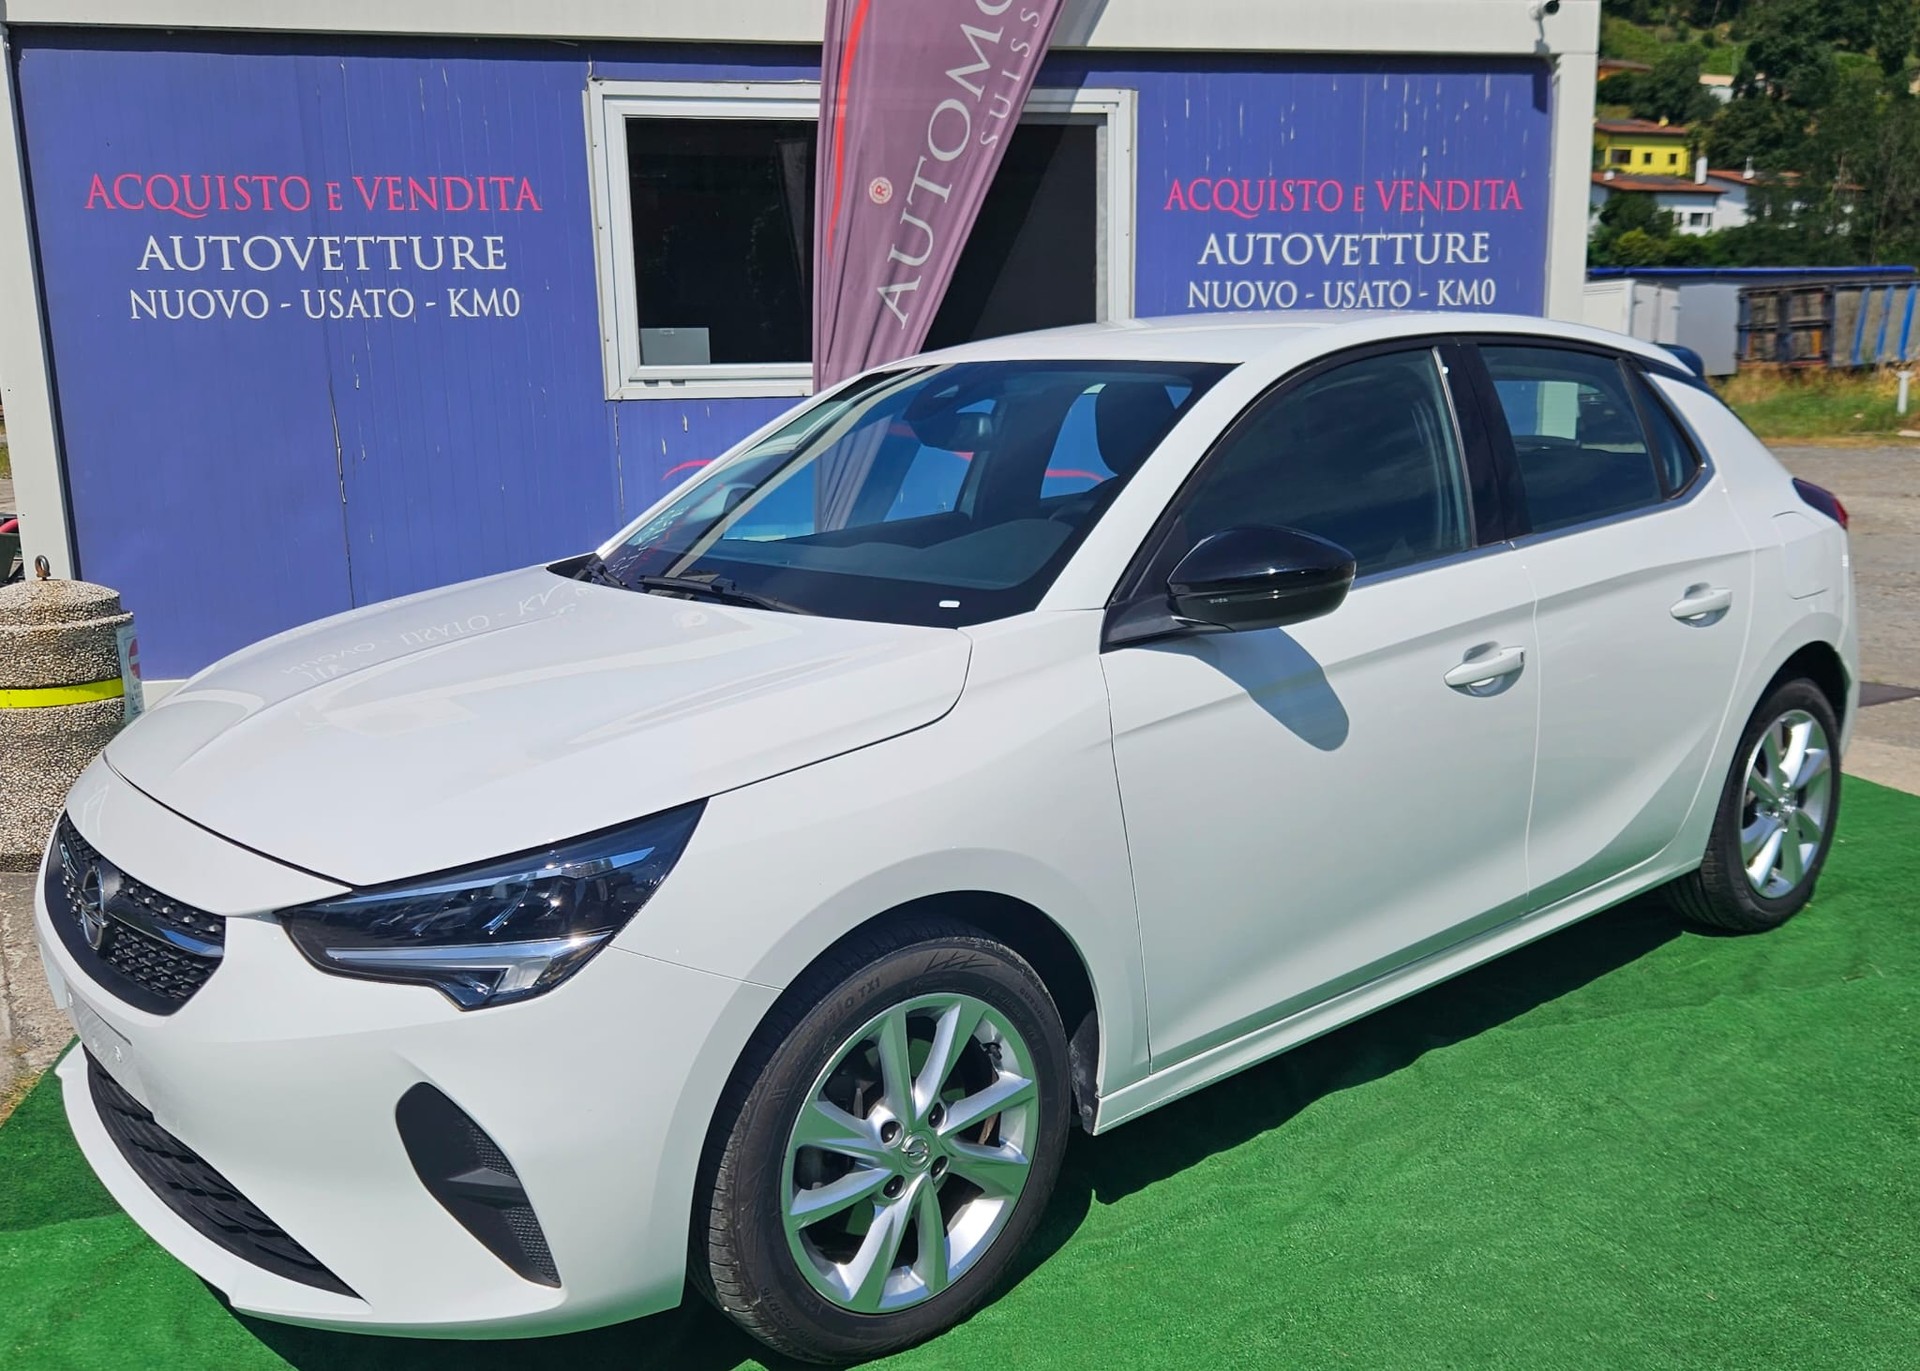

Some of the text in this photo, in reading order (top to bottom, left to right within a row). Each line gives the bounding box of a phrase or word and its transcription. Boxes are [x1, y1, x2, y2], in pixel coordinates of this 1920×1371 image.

[980, 8, 1040, 150] SUISS
[876, 0, 1012, 330] AUTOM
[85, 173, 542, 219] ACQUISTO E VENDITA
[1164, 178, 1523, 219] ACQUISTO E VENDITA
[137, 235, 507, 272] AUTOVETTURE
[1197, 232, 1490, 266] AUTOVETTURE
[130, 289, 269, 320] NUOVO
[301, 288, 415, 319] USATO
[448, 287, 520, 317] KM0
[1187, 280, 1298, 309] NUOVO
[1323, 279, 1412, 309] USATO
[1437, 278, 1496, 306] KM0
